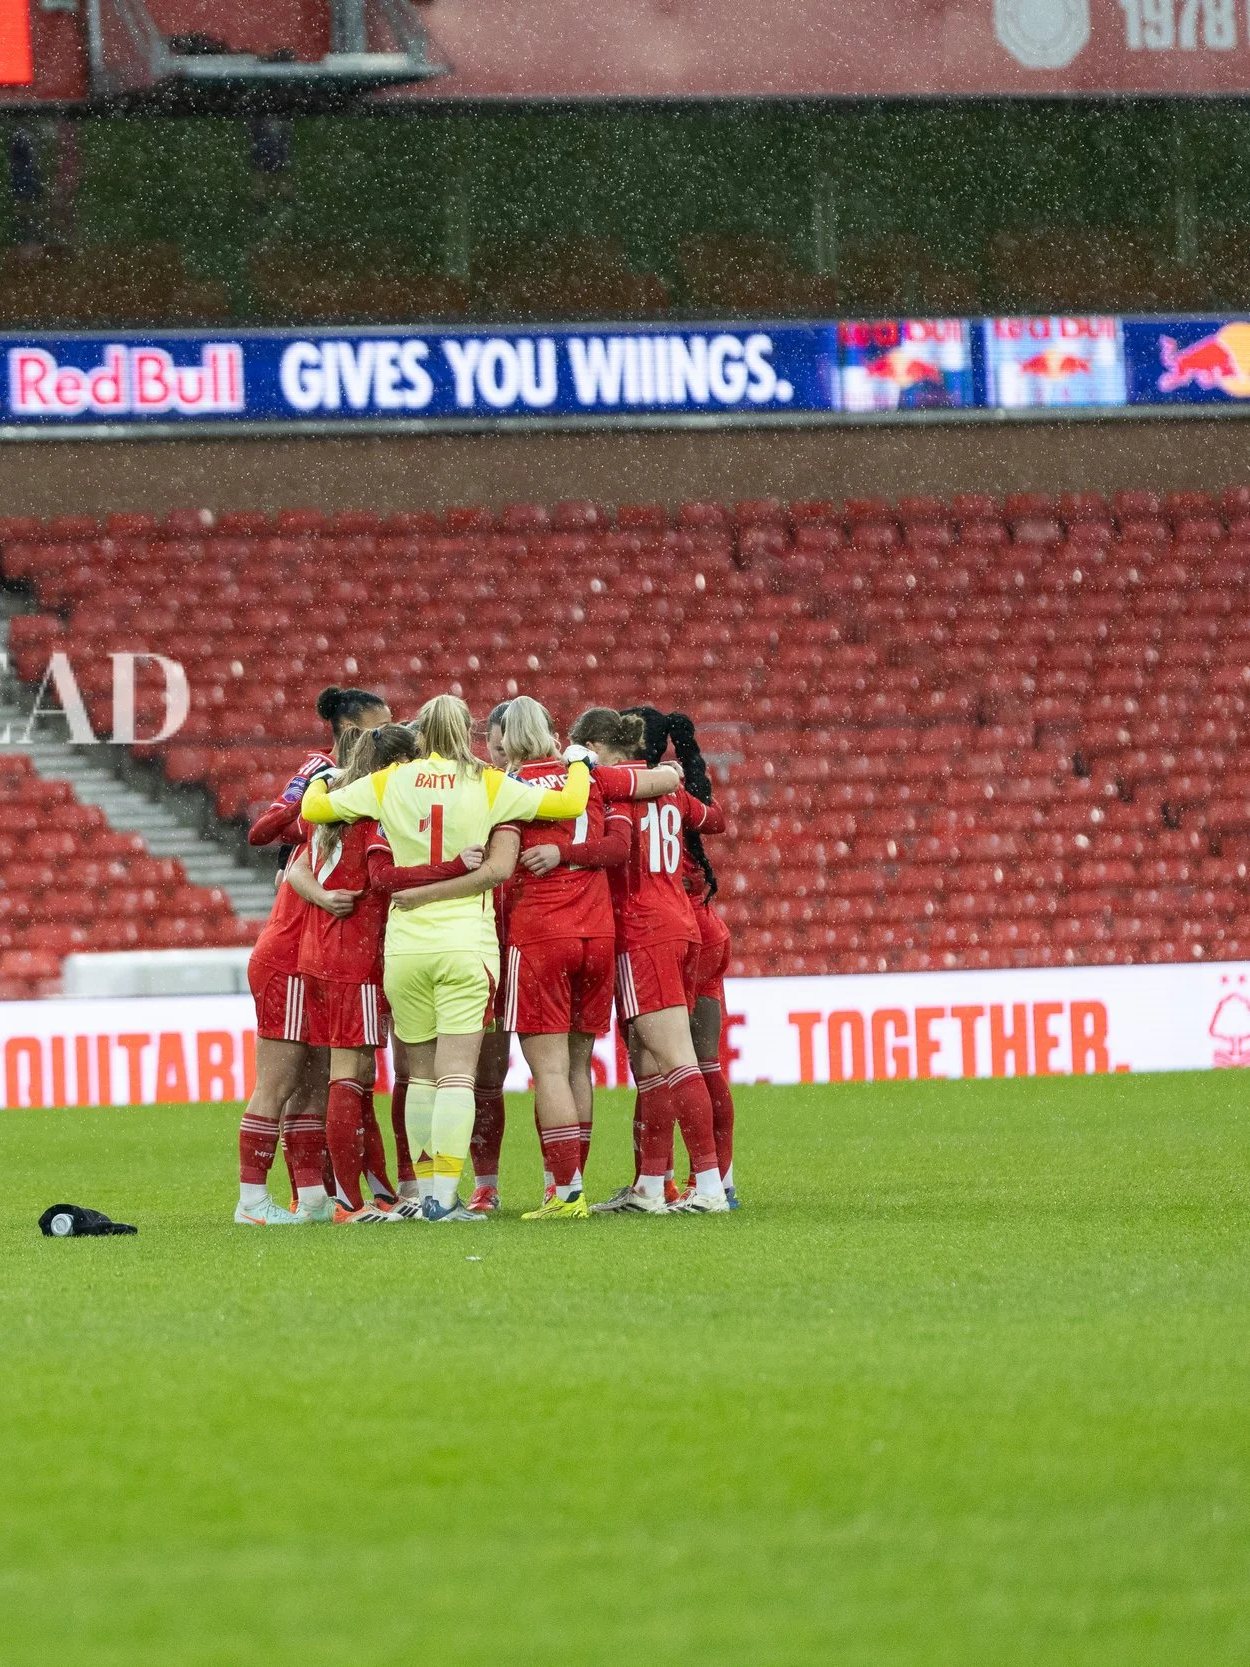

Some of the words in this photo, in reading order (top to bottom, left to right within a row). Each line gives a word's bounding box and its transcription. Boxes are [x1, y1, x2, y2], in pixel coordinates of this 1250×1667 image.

[280, 341, 433, 409] GIVES
[443, 339, 558, 408] YOU
[567, 333, 794, 406] WIIINGS.
[415, 773, 456, 789] BATTY
[418, 804, 444, 866] 1
[639, 801, 682, 874] 18
